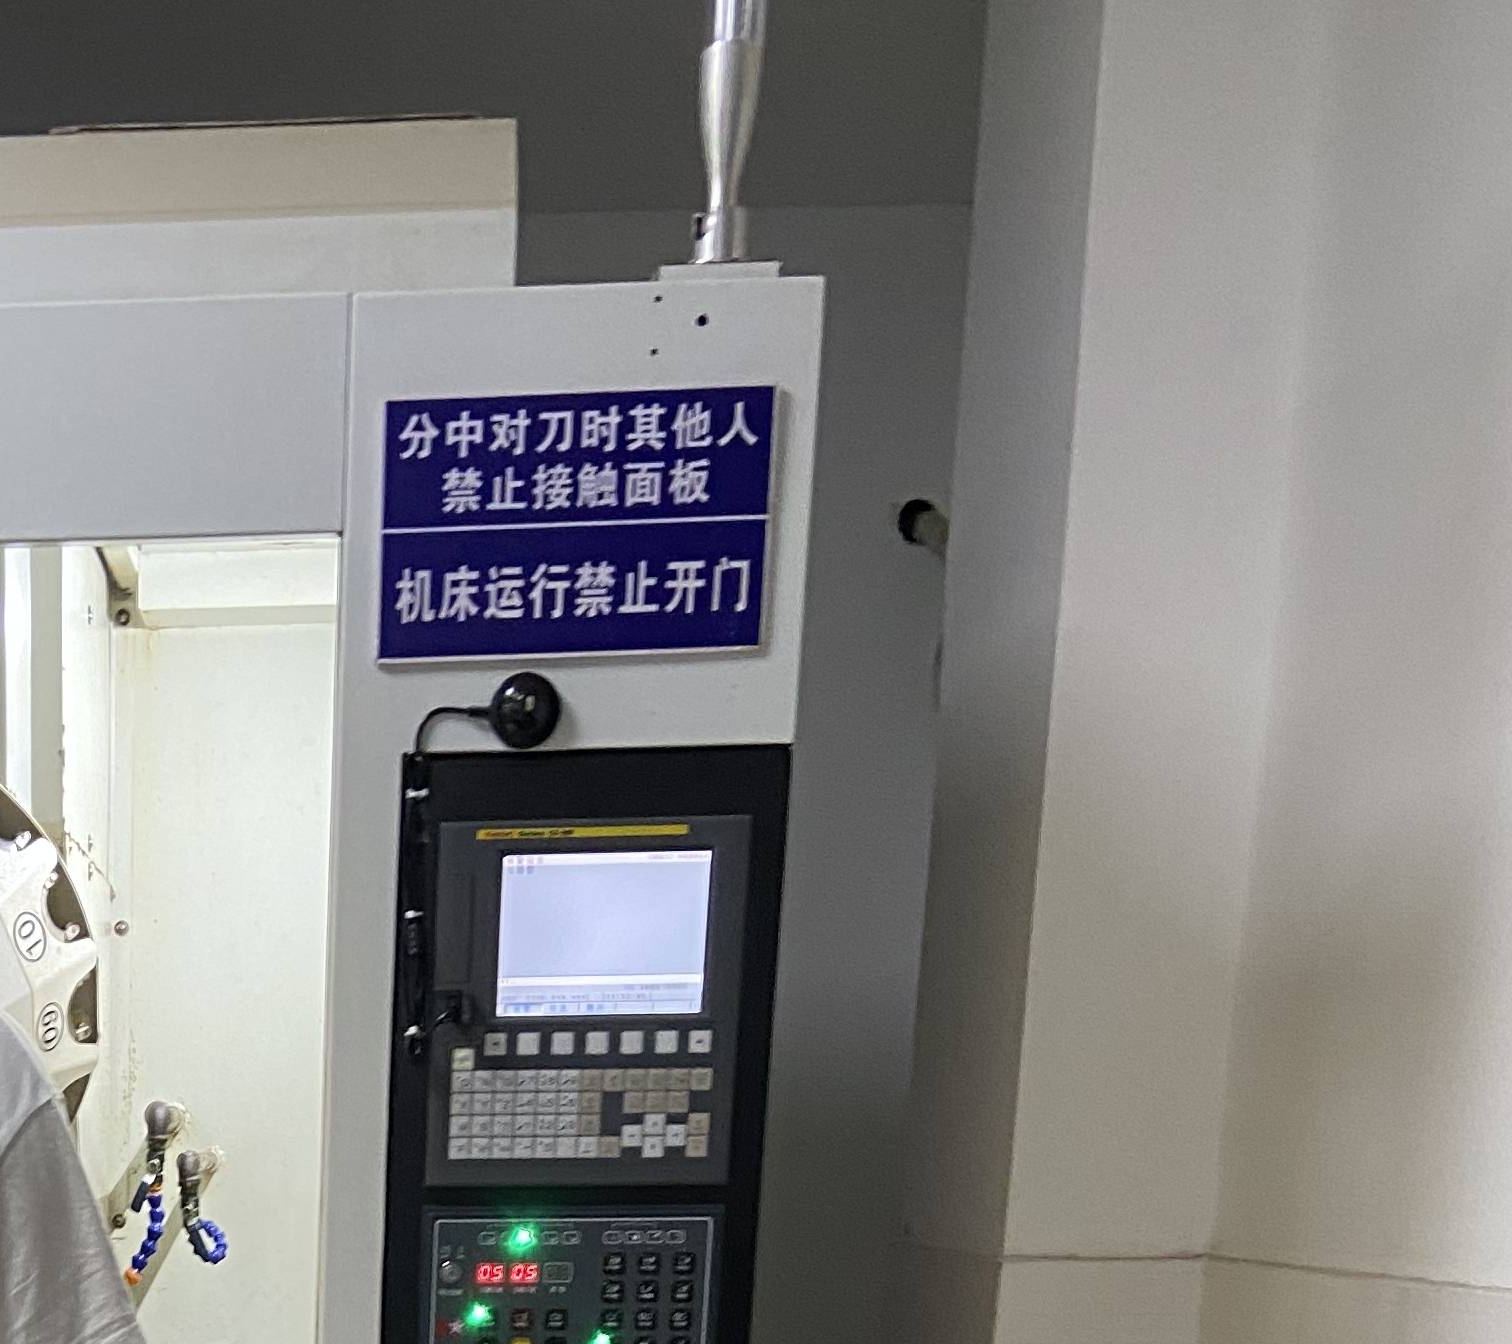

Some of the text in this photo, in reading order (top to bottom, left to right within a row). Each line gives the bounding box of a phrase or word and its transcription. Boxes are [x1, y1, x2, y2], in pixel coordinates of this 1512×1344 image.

[397, 401, 759, 460] 分中对刀时其他人
[441, 458, 711, 514] 禁止接触面板
[395, 556, 752, 625] 机床运行禁止开门
